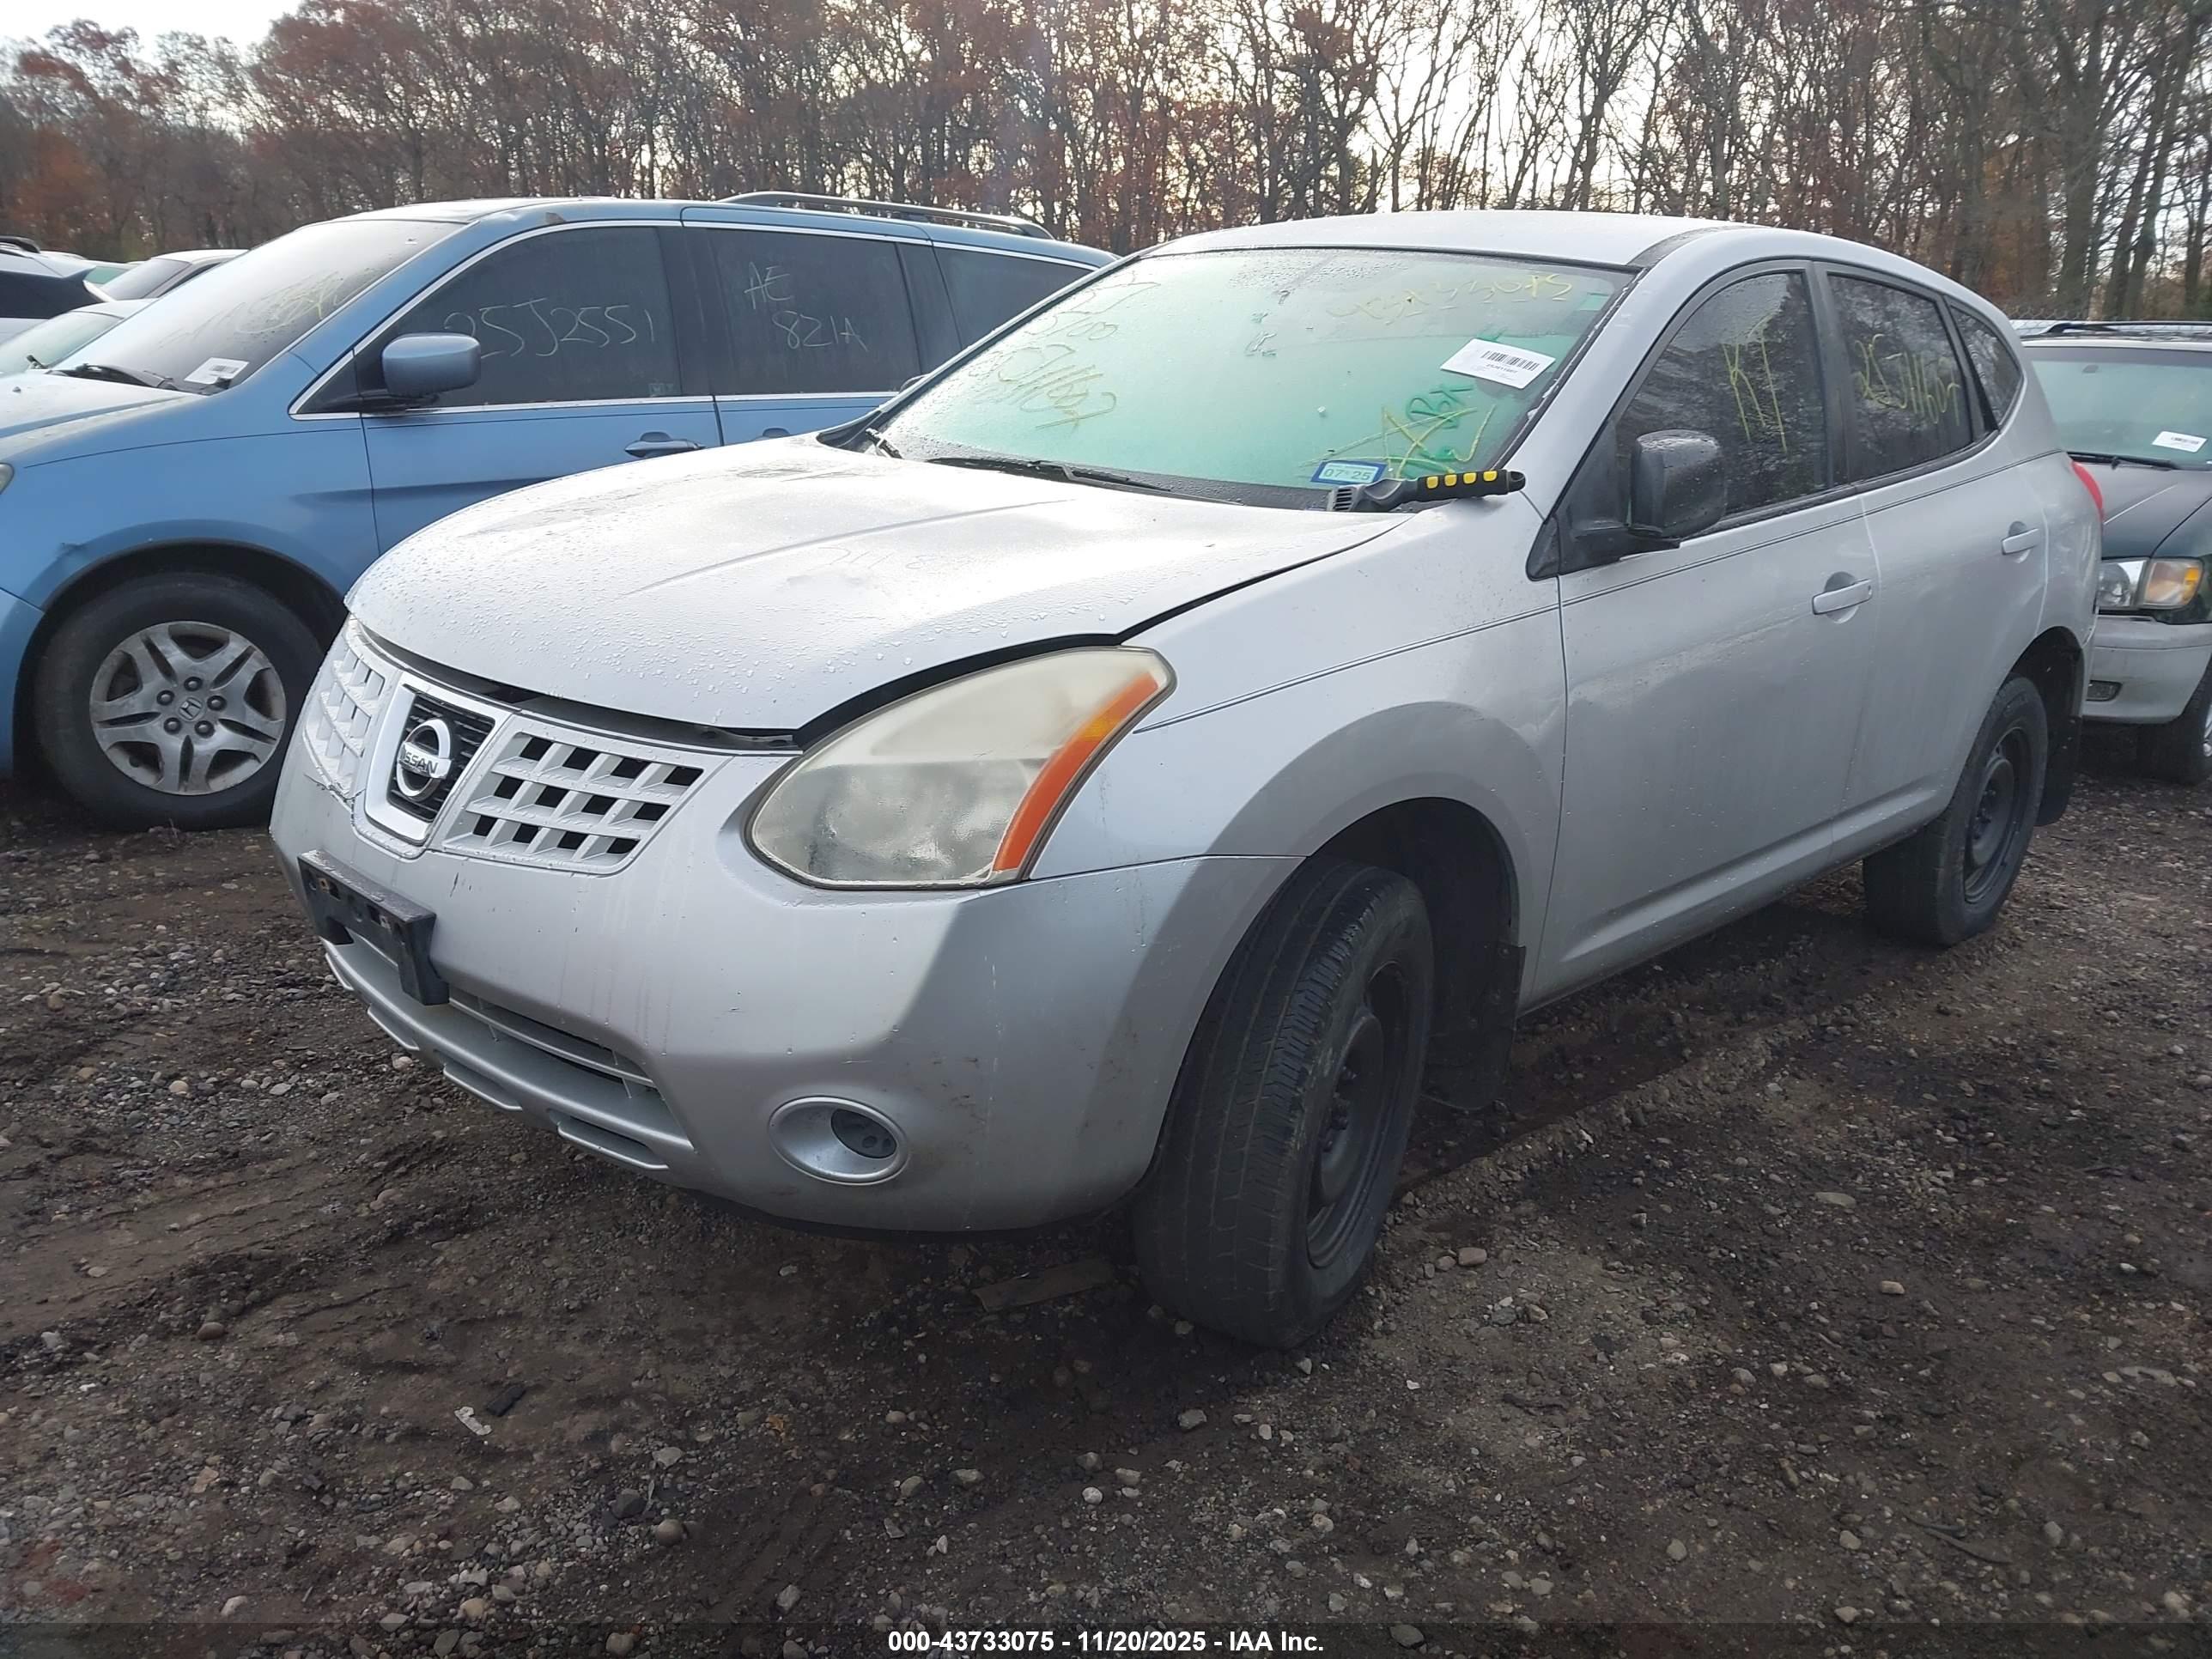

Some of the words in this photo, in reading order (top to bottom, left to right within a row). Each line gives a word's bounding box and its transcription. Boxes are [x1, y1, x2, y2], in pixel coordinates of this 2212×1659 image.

[744, 261, 794, 309] AE
[1323, 468, 1344, 478] 07
[1351, 470, 1372, 481] 25
[399, 744, 440, 775] SSAN
